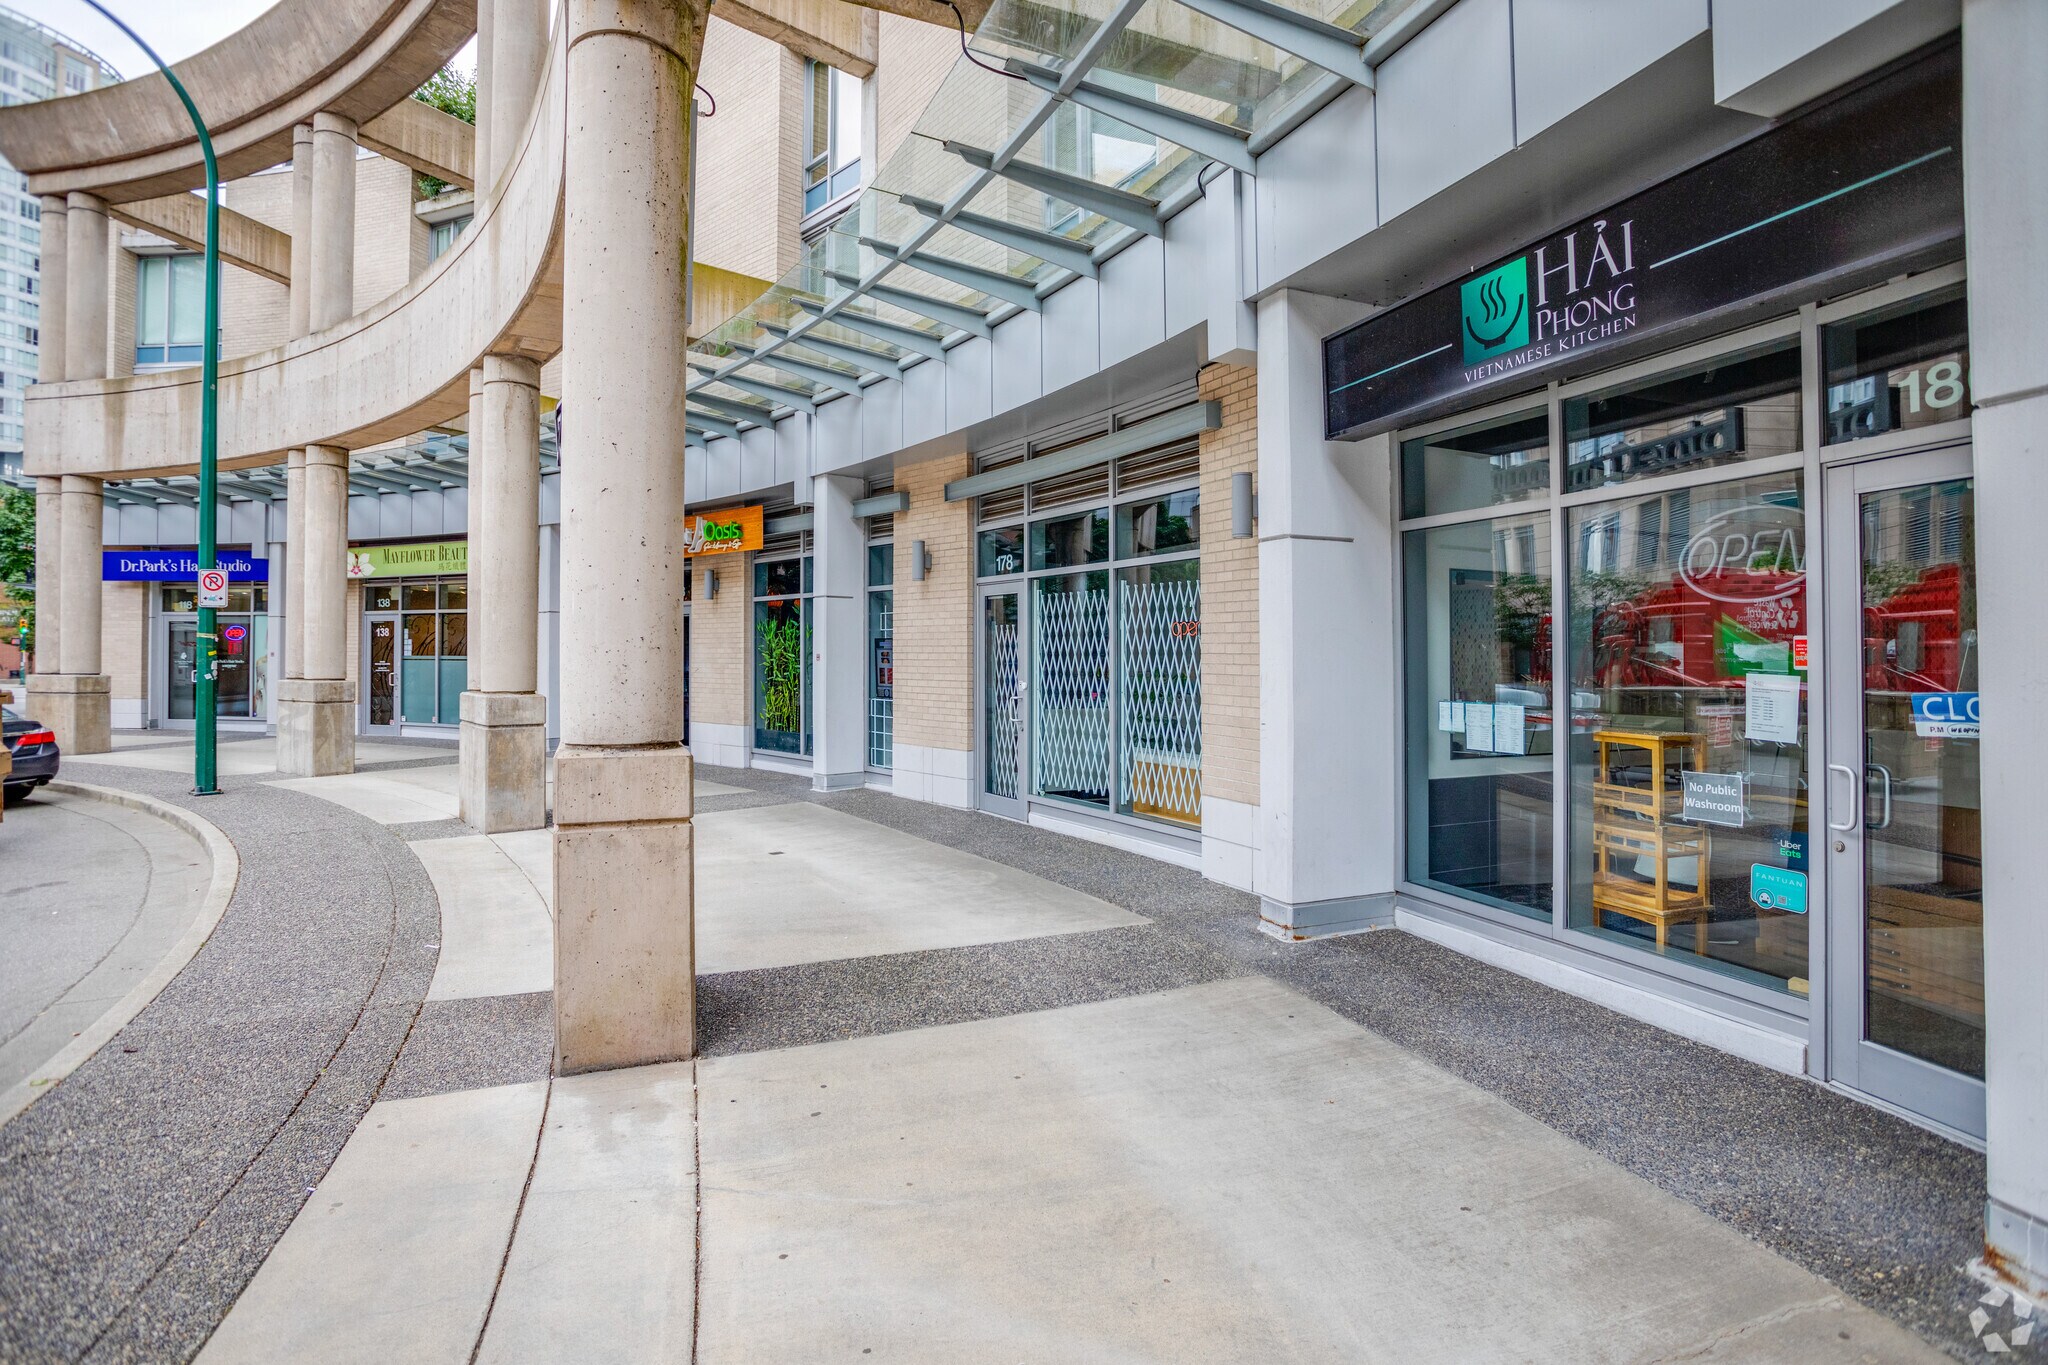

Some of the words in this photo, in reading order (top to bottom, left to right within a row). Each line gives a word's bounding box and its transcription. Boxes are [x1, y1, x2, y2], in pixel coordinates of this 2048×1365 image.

[1534, 220, 1635, 307] HẢI
[1536, 283, 1636, 341] PHONG
[1464, 343, 1552, 383] VIETNAMESE
[1559, 313, 1637, 352] KITCHEN
[1897, 361, 1971, 413] 18
[383, 548, 436, 564] MAYFLOWER
[996, 554, 1013, 571] 178
[120, 559, 177, 572] Dr.Park's
[178, 601, 193, 609] 118
[377, 598, 391, 607] 138
[375, 627, 389, 637] 138
[1689, 782, 1703, 793] No
[1705, 783, 1737, 797] Public
[1684, 796, 1741, 813] Washroom
[1780, 839, 1801, 850] Uber
[1780, 848, 1801, 859] Eats
[1755, 872, 1803, 888] FANTUAN
